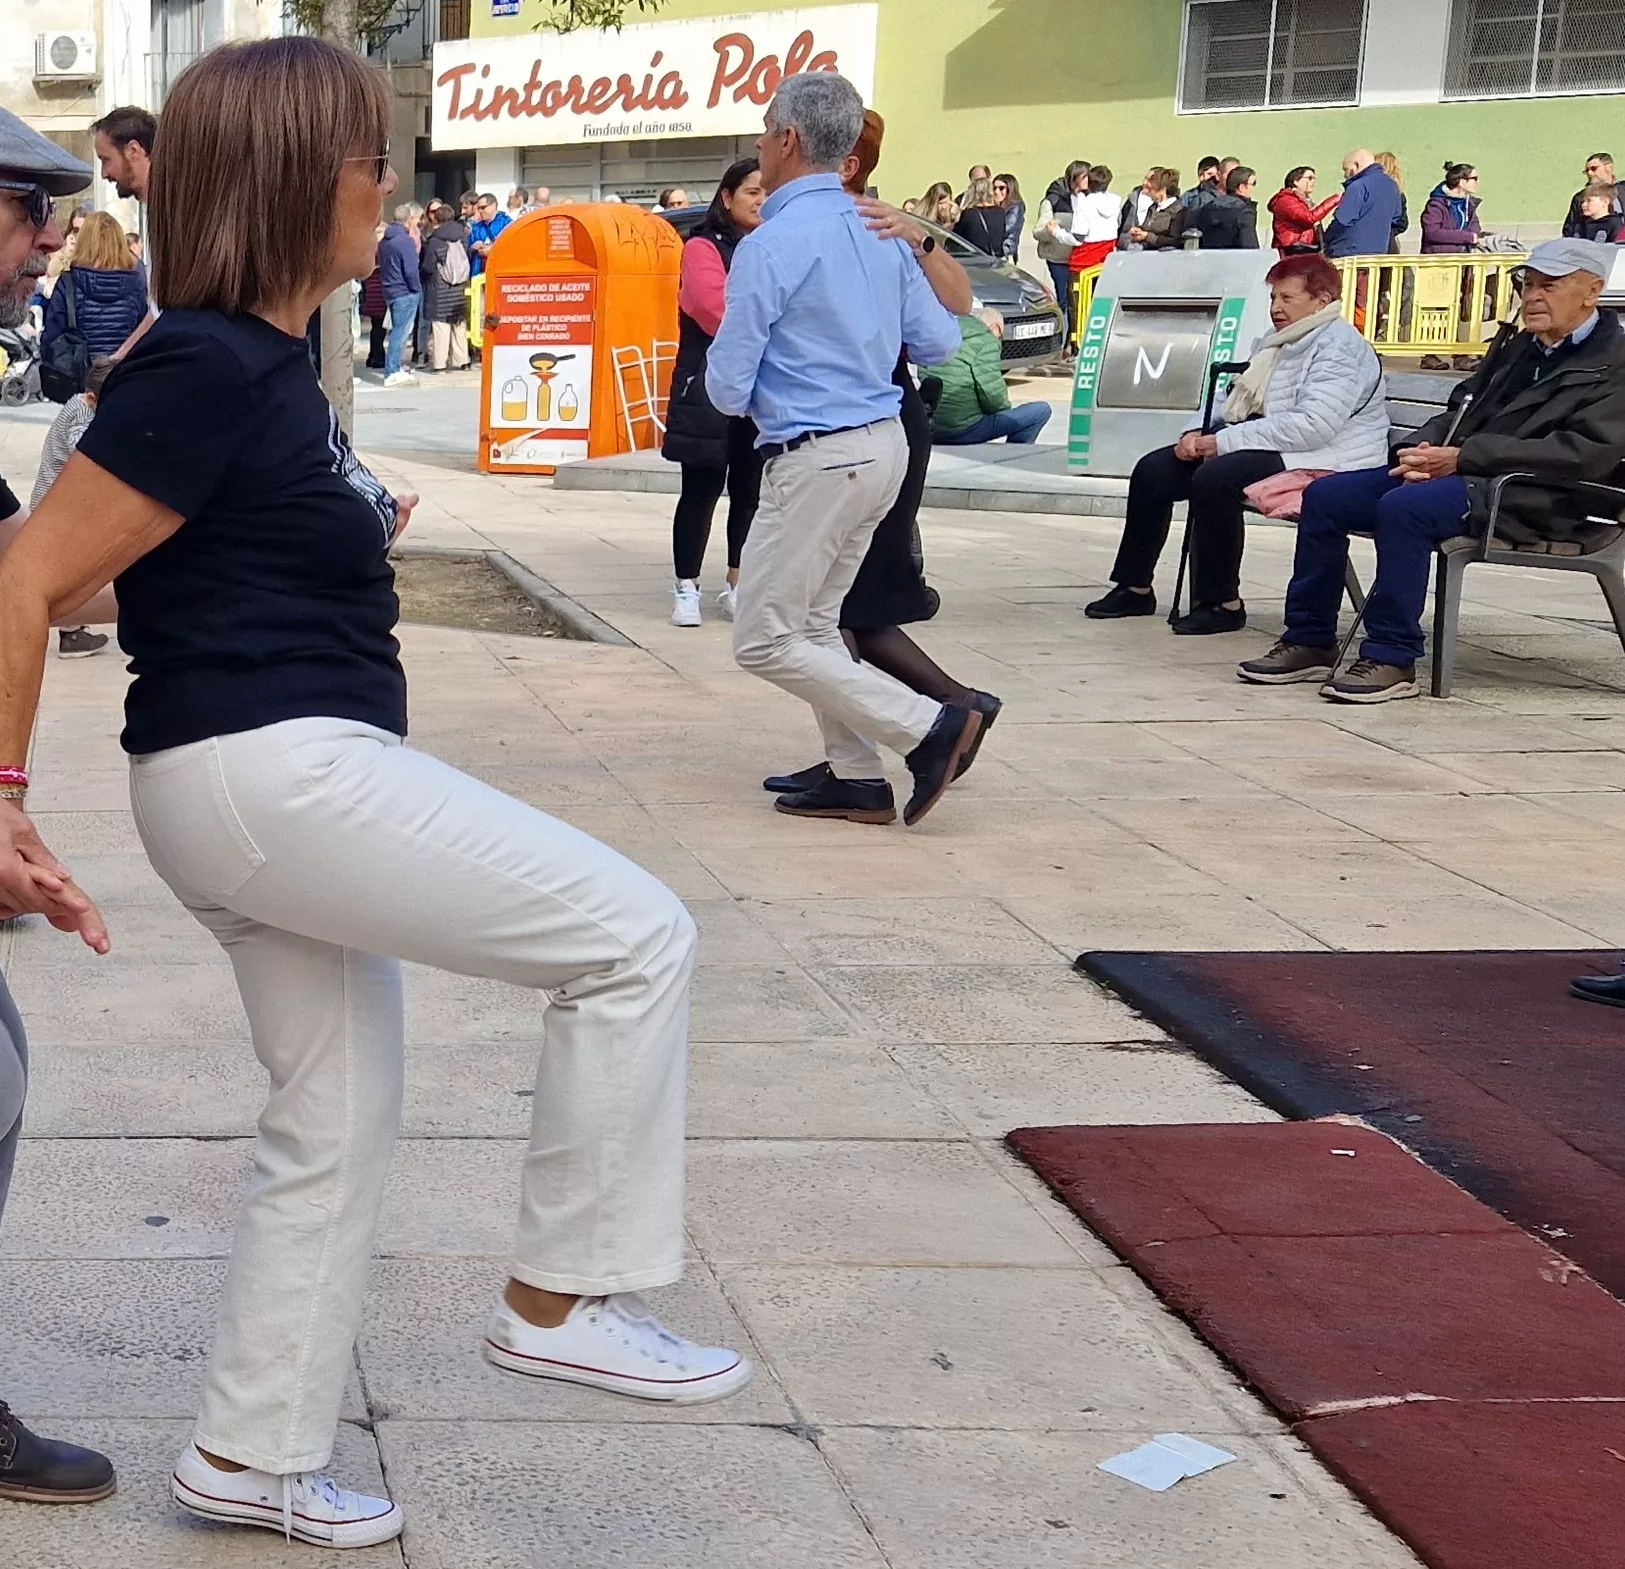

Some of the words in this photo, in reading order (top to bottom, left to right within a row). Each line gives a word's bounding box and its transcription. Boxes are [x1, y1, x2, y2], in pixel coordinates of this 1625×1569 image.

[436, 51, 689, 122] Tintorería
[583, 122, 630, 138] Fundada
[632, 120, 643, 134] el
[645, 121, 666, 134] año
[501, 284, 547, 293] RECICLADO
[549, 283, 560, 292] DE
[561, 283, 590, 292] ACEITE
[507, 293, 554, 303] DOMÉSTICO
[555, 293, 584, 302] USADO
[538, 315, 548, 323] EN
[549, 314, 591, 323] RECIPIENTE
[521, 324, 531, 332] DE
[535, 332, 570, 340] CERRADO
[1078, 315, 1106, 389] RESTO
[1133, 343, 1174, 385] N
